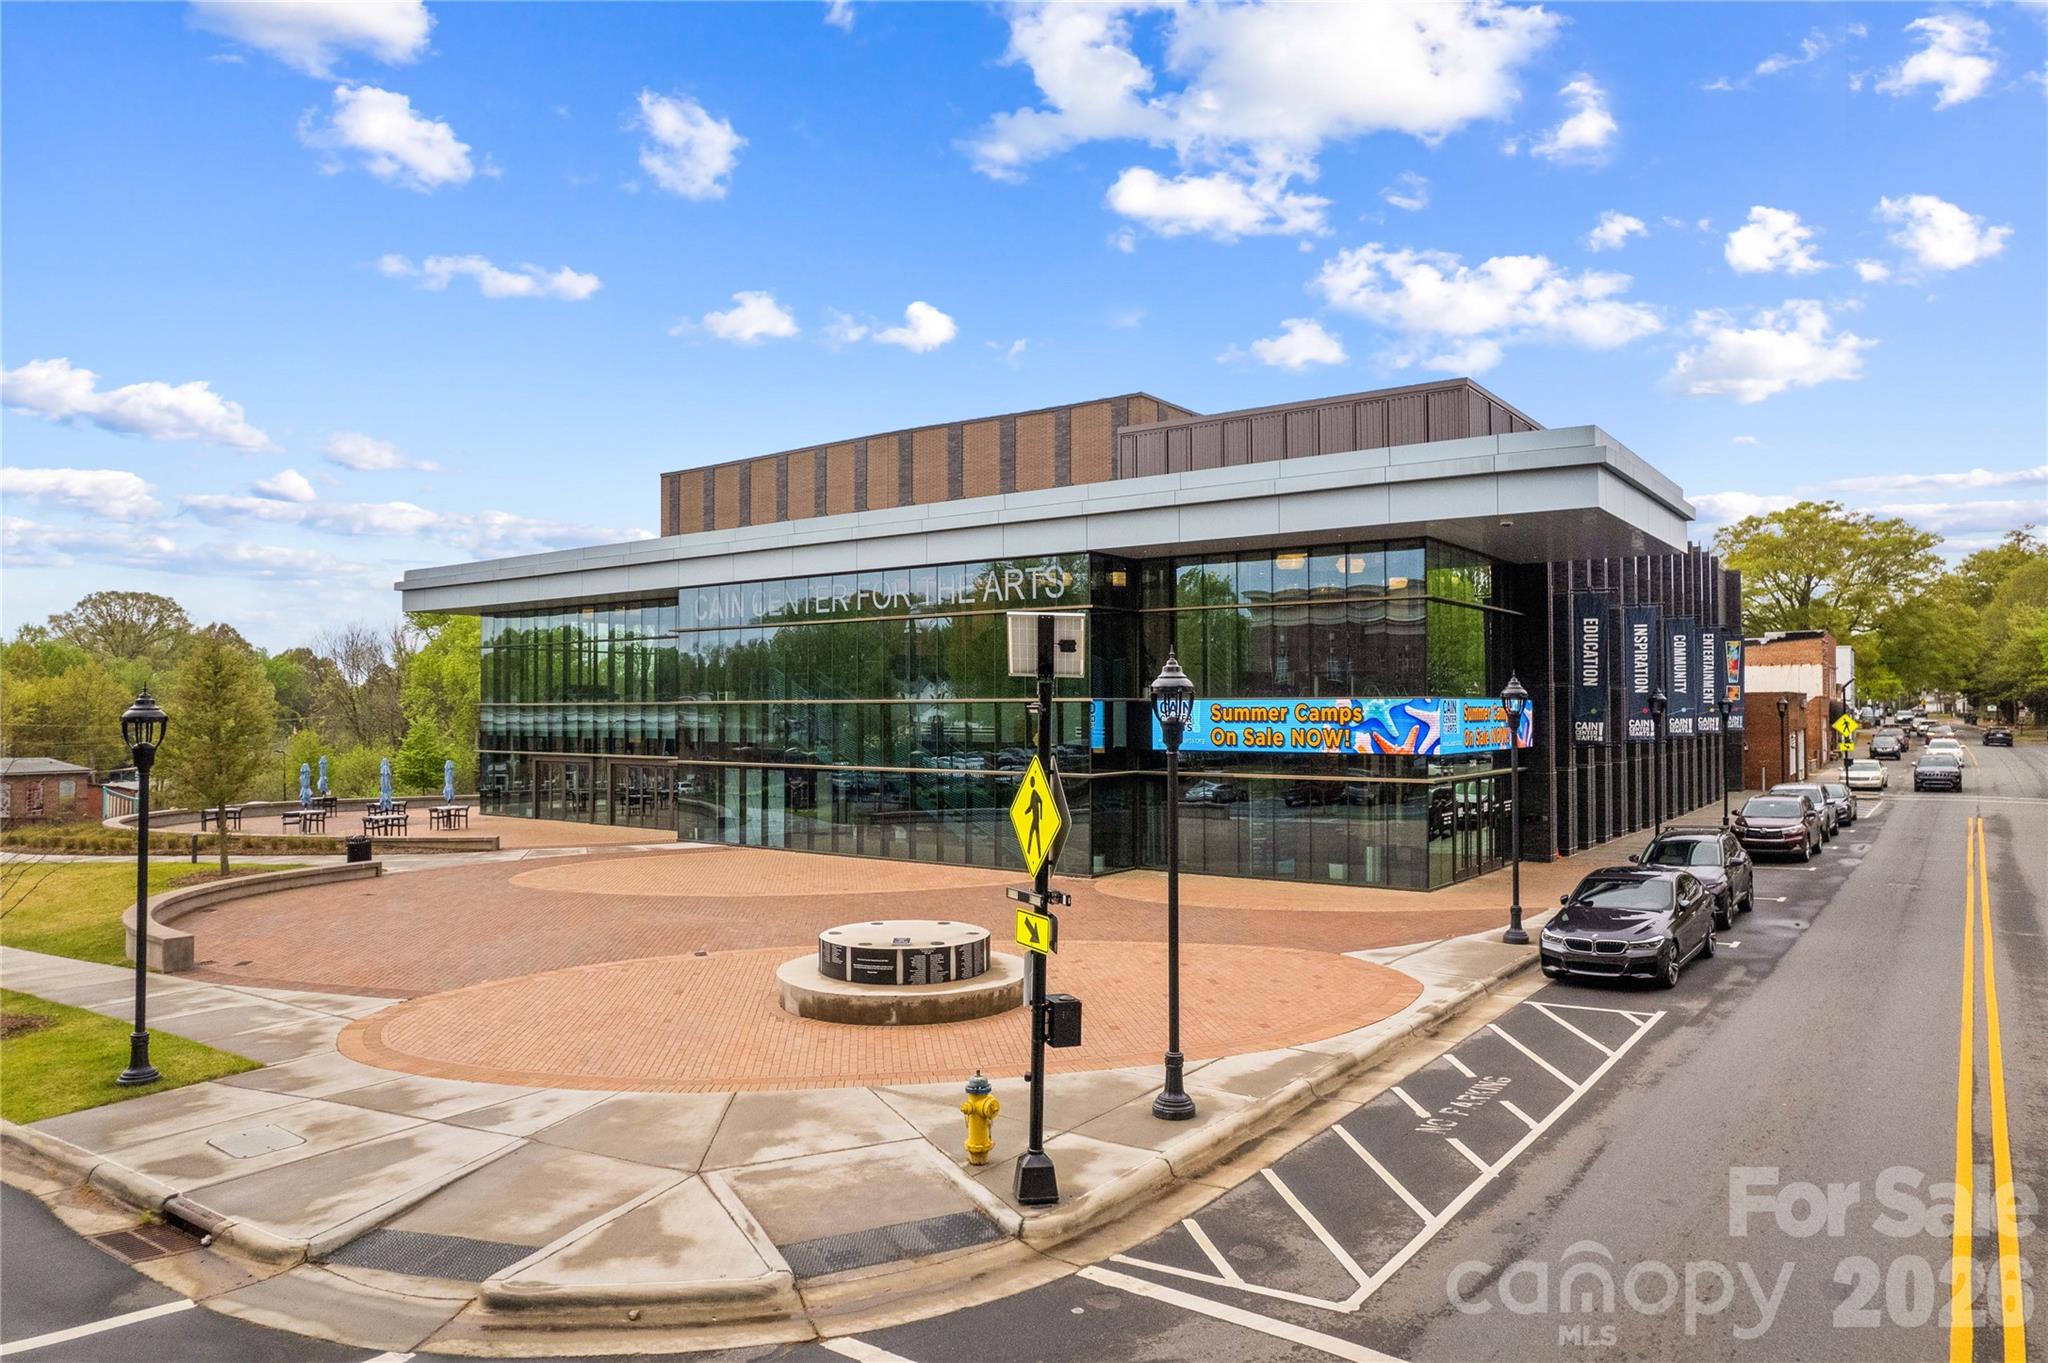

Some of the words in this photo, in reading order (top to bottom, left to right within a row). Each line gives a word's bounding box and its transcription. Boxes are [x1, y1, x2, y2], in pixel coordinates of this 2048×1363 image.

[695, 590, 744, 621] CAIN
[752, 583, 849, 617] CENTER
[857, 579, 911, 611] FOR
[918, 572, 976, 606] THE
[983, 565, 1065, 603] ARTS
[1582, 617, 1599, 687] EDUCATION
[1633, 623, 1649, 694] INSPIRATION
[1673, 634, 1687, 694] COMMUNITY
[1702, 633, 1715, 705] ENTERTAINMENT
[1210, 703, 1289, 723] Summer
[1294, 703, 1364, 726] Camps
[1443, 701, 1457, 714] CAIN
[1575, 722, 1598, 730] CAIN
[1629, 719, 1650, 727] CAIN
[1210, 727, 1238, 747] On
[1243, 727, 1285, 747] Sale
[1291, 728, 1351, 748] NOW!
